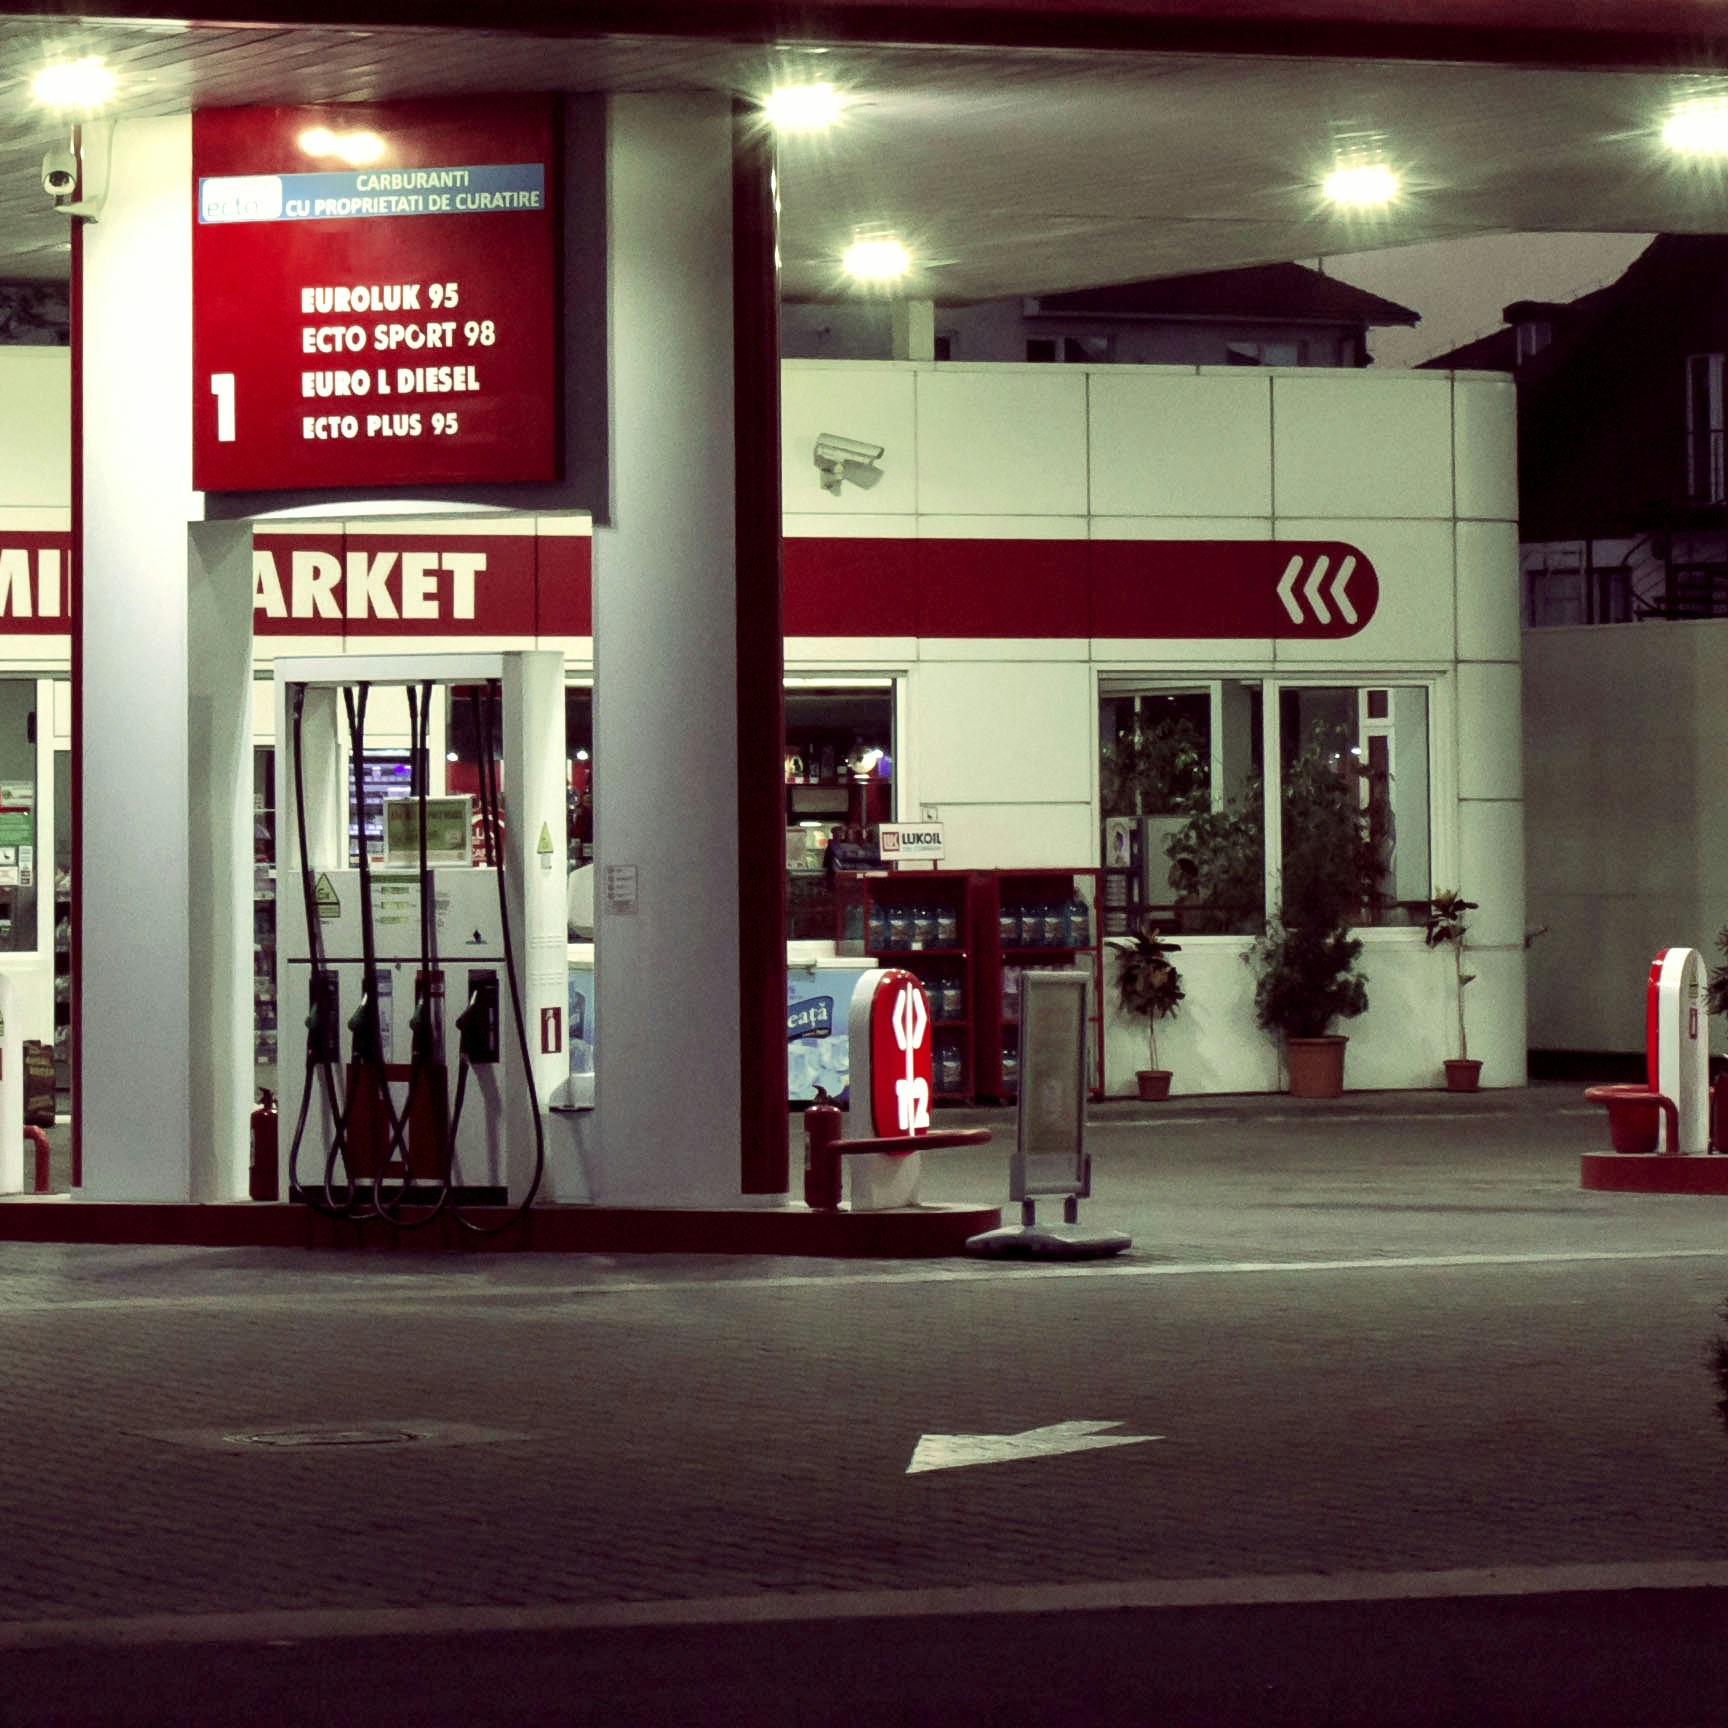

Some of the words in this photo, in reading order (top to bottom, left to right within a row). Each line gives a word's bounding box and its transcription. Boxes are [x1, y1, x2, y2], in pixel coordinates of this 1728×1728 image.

[356, 170, 470, 193] CARBURANTI
[285, 199, 311, 217] CU
[314, 195, 424, 217] PROPRIETATI
[428, 193, 452, 212] DE
[455, 190, 540, 210] CURATIRE
[301, 284, 421, 313] EUROLUK
[428, 283, 459, 309] 95
[302, 325, 367, 354] ECTO
[373, 322, 457, 351] SPORT
[463, 320, 497, 347] 98
[301, 369, 371, 398] EURO
[377, 369, 392, 395] L
[396, 366, 481, 394] DIESEL
[210, 372, 236, 443] 1
[302, 416, 359, 440] ECTO
[367, 414, 423, 438] PLUS
[431, 412, 460, 435] 95
[902, 833, 942, 844] LUKOIL
